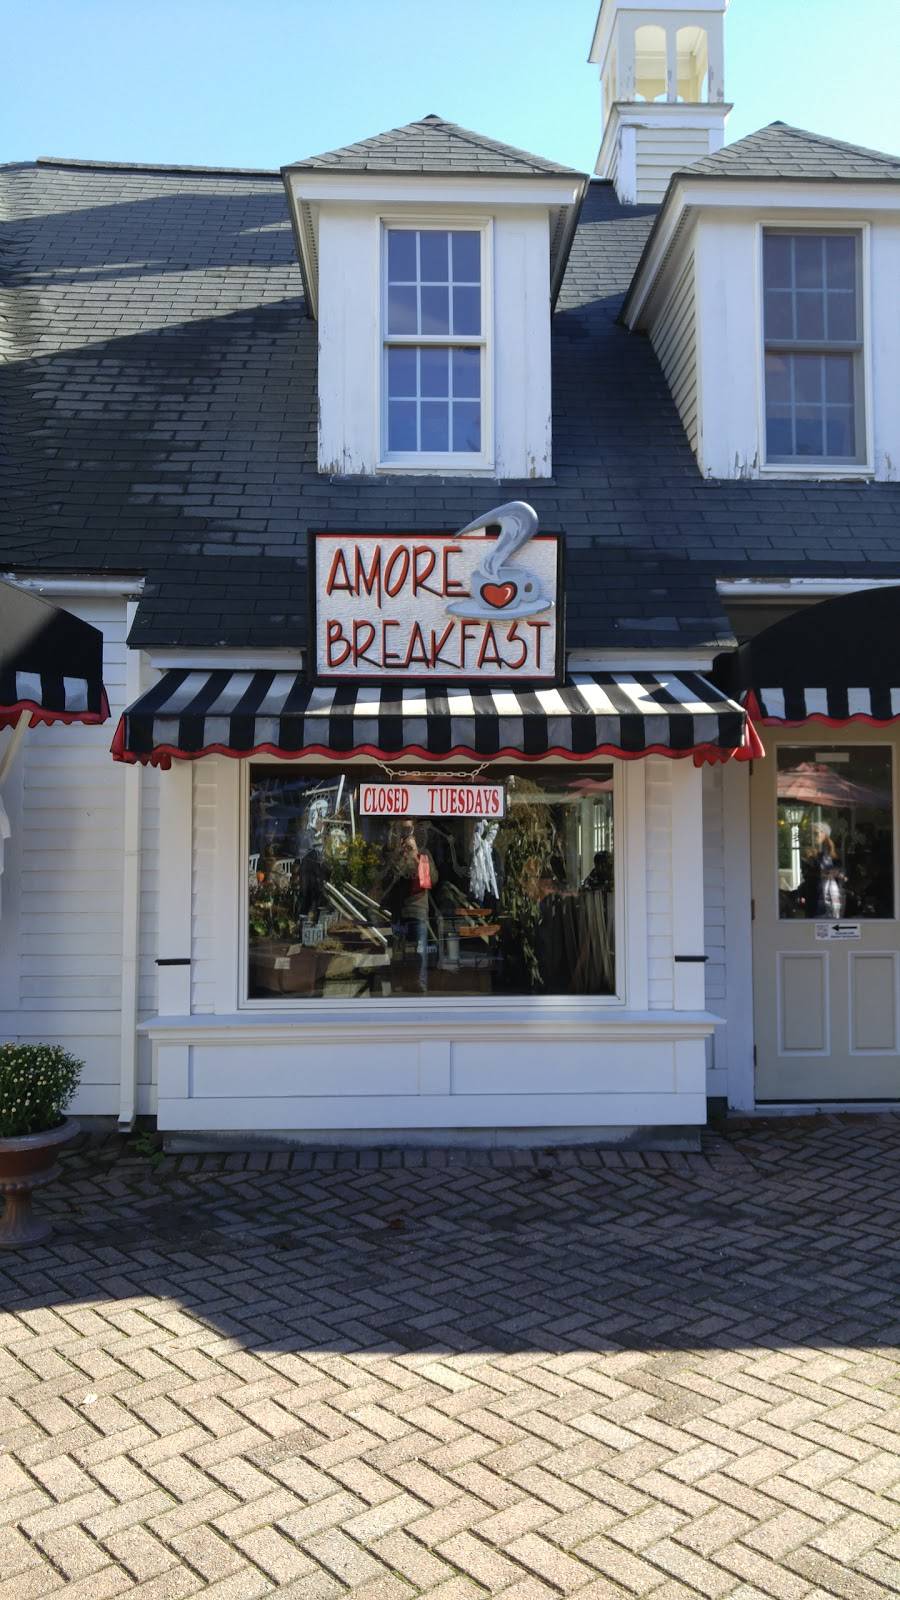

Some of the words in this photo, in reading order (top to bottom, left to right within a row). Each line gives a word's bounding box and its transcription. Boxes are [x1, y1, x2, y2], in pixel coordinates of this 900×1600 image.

[326, 544, 471, 608] AMORE
[326, 618, 550, 669] BREAKFAST
[363, 786, 409, 813] CLOSED
[427, 788, 499, 814] TUESDAYS
